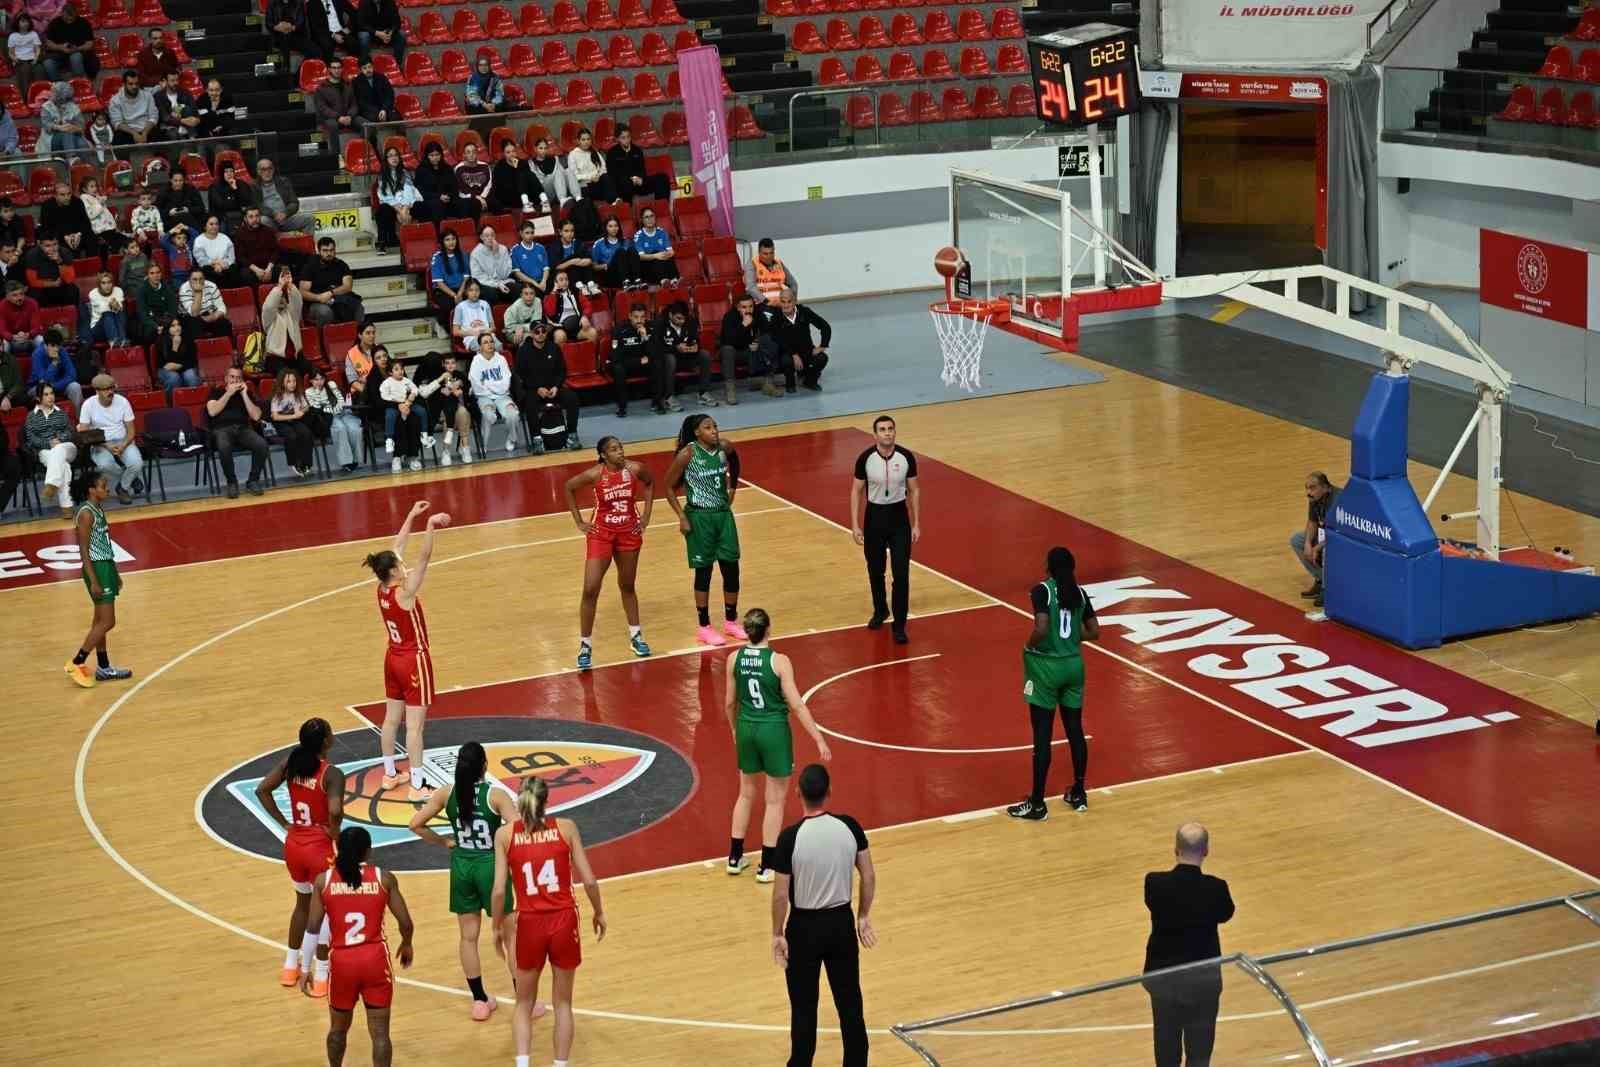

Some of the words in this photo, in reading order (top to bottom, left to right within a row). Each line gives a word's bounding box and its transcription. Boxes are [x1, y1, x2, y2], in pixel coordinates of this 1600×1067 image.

[1220, 5, 1234, 16] İL
[1091, 41, 1125, 67] 6:22
[1040, 79, 1068, 119] 24
[1084, 73, 1125, 118] 24
[714, 476, 721, 489] 3
[1345, 512, 1392, 541] HALKBANK
[748, 678, 765, 709] 9
[296, 801, 313, 827] 3
[456, 818, 493, 850] 23
[522, 858, 560, 896] 14
[344, 912, 366, 946] 2
